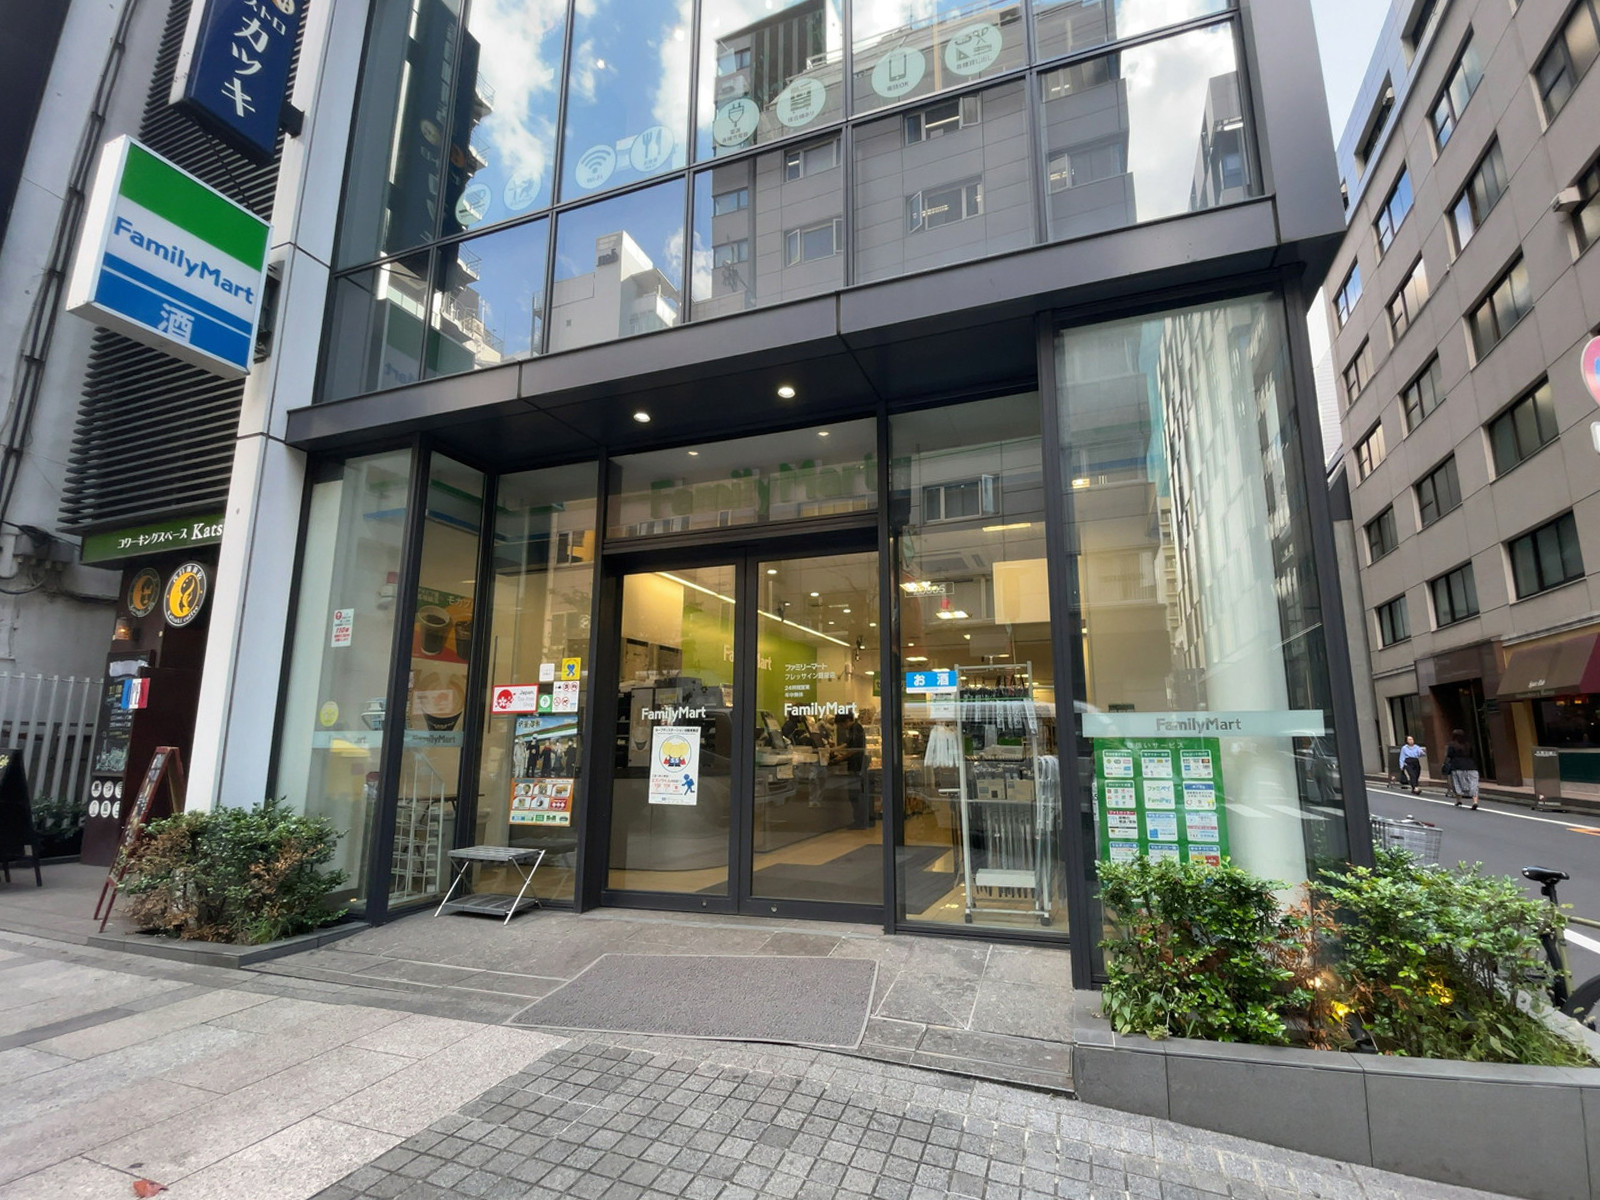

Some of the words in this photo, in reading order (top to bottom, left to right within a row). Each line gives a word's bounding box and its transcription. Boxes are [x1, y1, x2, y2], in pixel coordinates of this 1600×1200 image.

[220, 16, 270, 117] カツキ
[112, 216, 255, 306] FamilyMart
[158, 302, 196, 344] 酒
[784, 662, 828, 672] ファミリーマート
[641, 705, 707, 724] FamilyMart
[783, 701, 858, 718] FamilyMart
[1155, 716, 1242, 735] FamilyMart
[1147, 796, 1172, 805] FamiPay
